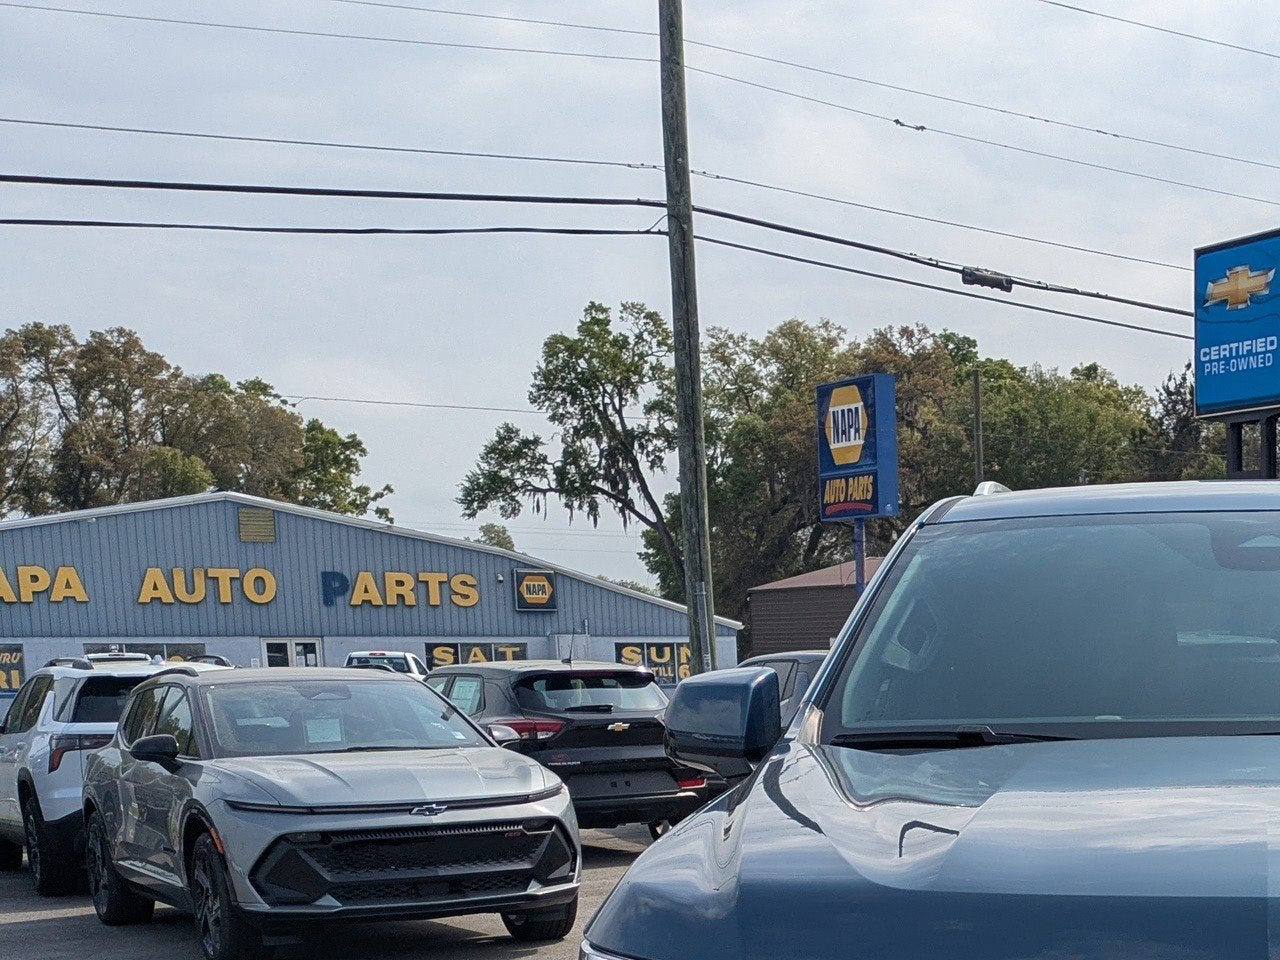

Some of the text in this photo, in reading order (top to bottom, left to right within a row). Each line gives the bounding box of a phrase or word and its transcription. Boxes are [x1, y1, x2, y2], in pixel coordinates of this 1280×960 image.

[1200, 336, 1278, 361] CERTIFIED
[1204, 353, 1273, 375] PRE-OWNED
[832, 406, 861, 444] NAPA
[824, 475, 874, 504] AUTO PARTS
[137, 567, 278, 604] AUTO
[321, 571, 480, 608] PARTS
[525, 583, 548, 596] NAPA
